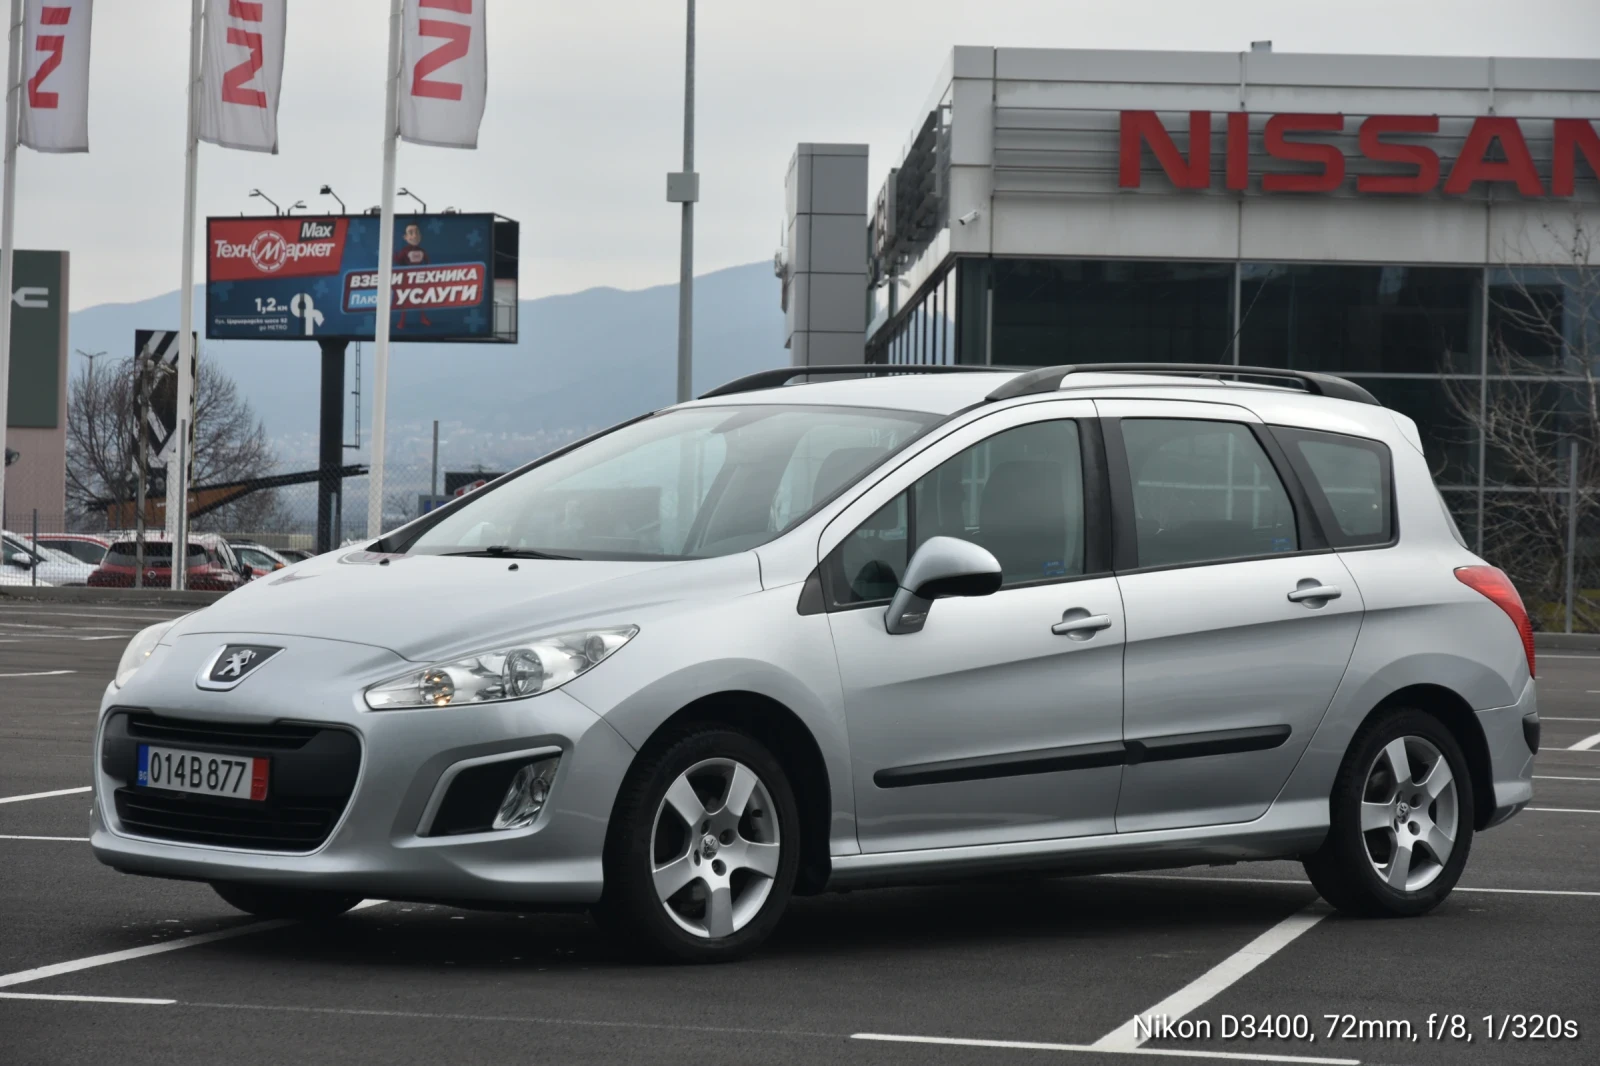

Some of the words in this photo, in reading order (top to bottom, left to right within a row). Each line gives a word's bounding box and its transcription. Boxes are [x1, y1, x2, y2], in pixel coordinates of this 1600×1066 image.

[301, 222, 332, 238] Max
[350, 272, 403, 288] ВЗЕИ
[407, 268, 478, 284] ТЕХНИКА
[396, 285, 478, 305] УСЛУГИ
[255, 297, 276, 314] 1,2
[151, 752, 247, 793] 014B877
